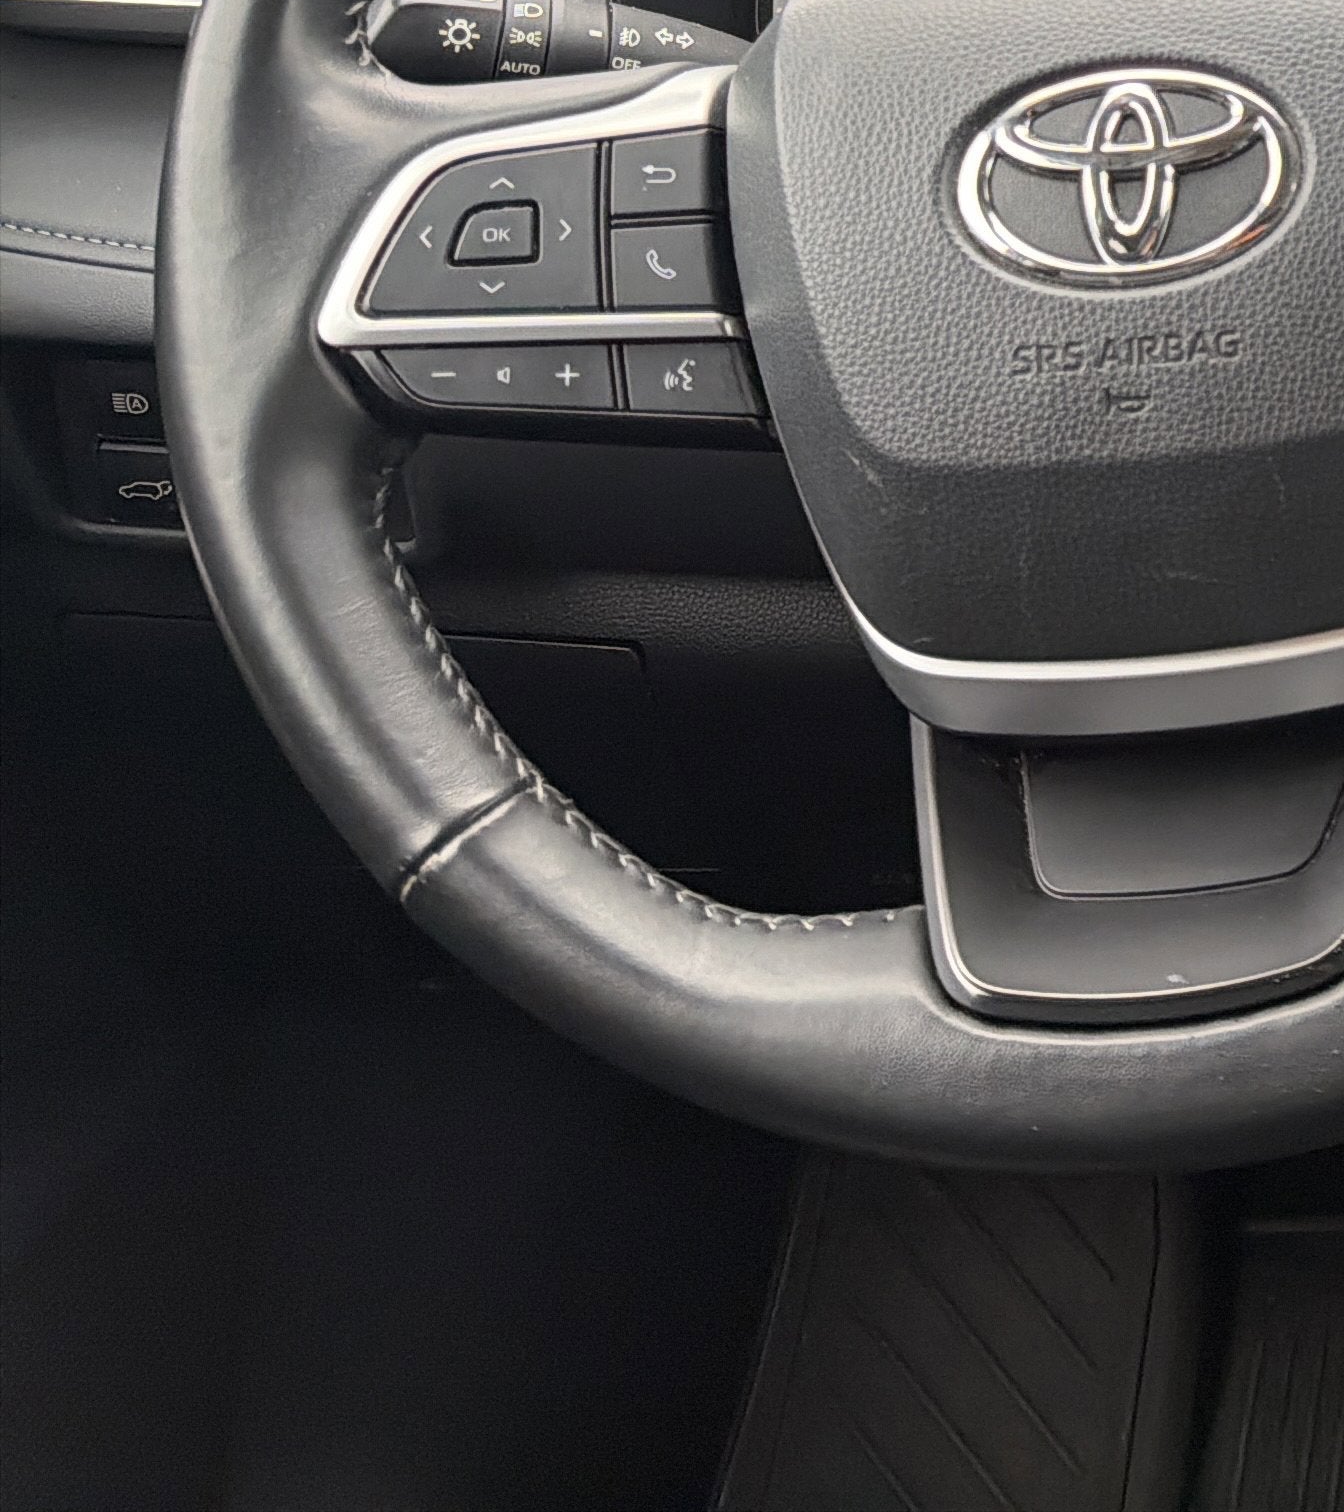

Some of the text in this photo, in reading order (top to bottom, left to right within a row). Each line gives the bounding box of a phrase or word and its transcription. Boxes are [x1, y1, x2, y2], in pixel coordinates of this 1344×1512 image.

[500, 60, 541, 76] AUTO
[611, 56, 642, 71] OFF
[482, 227, 511, 243] OK
[1096, 329, 1243, 370] AIRBAG
